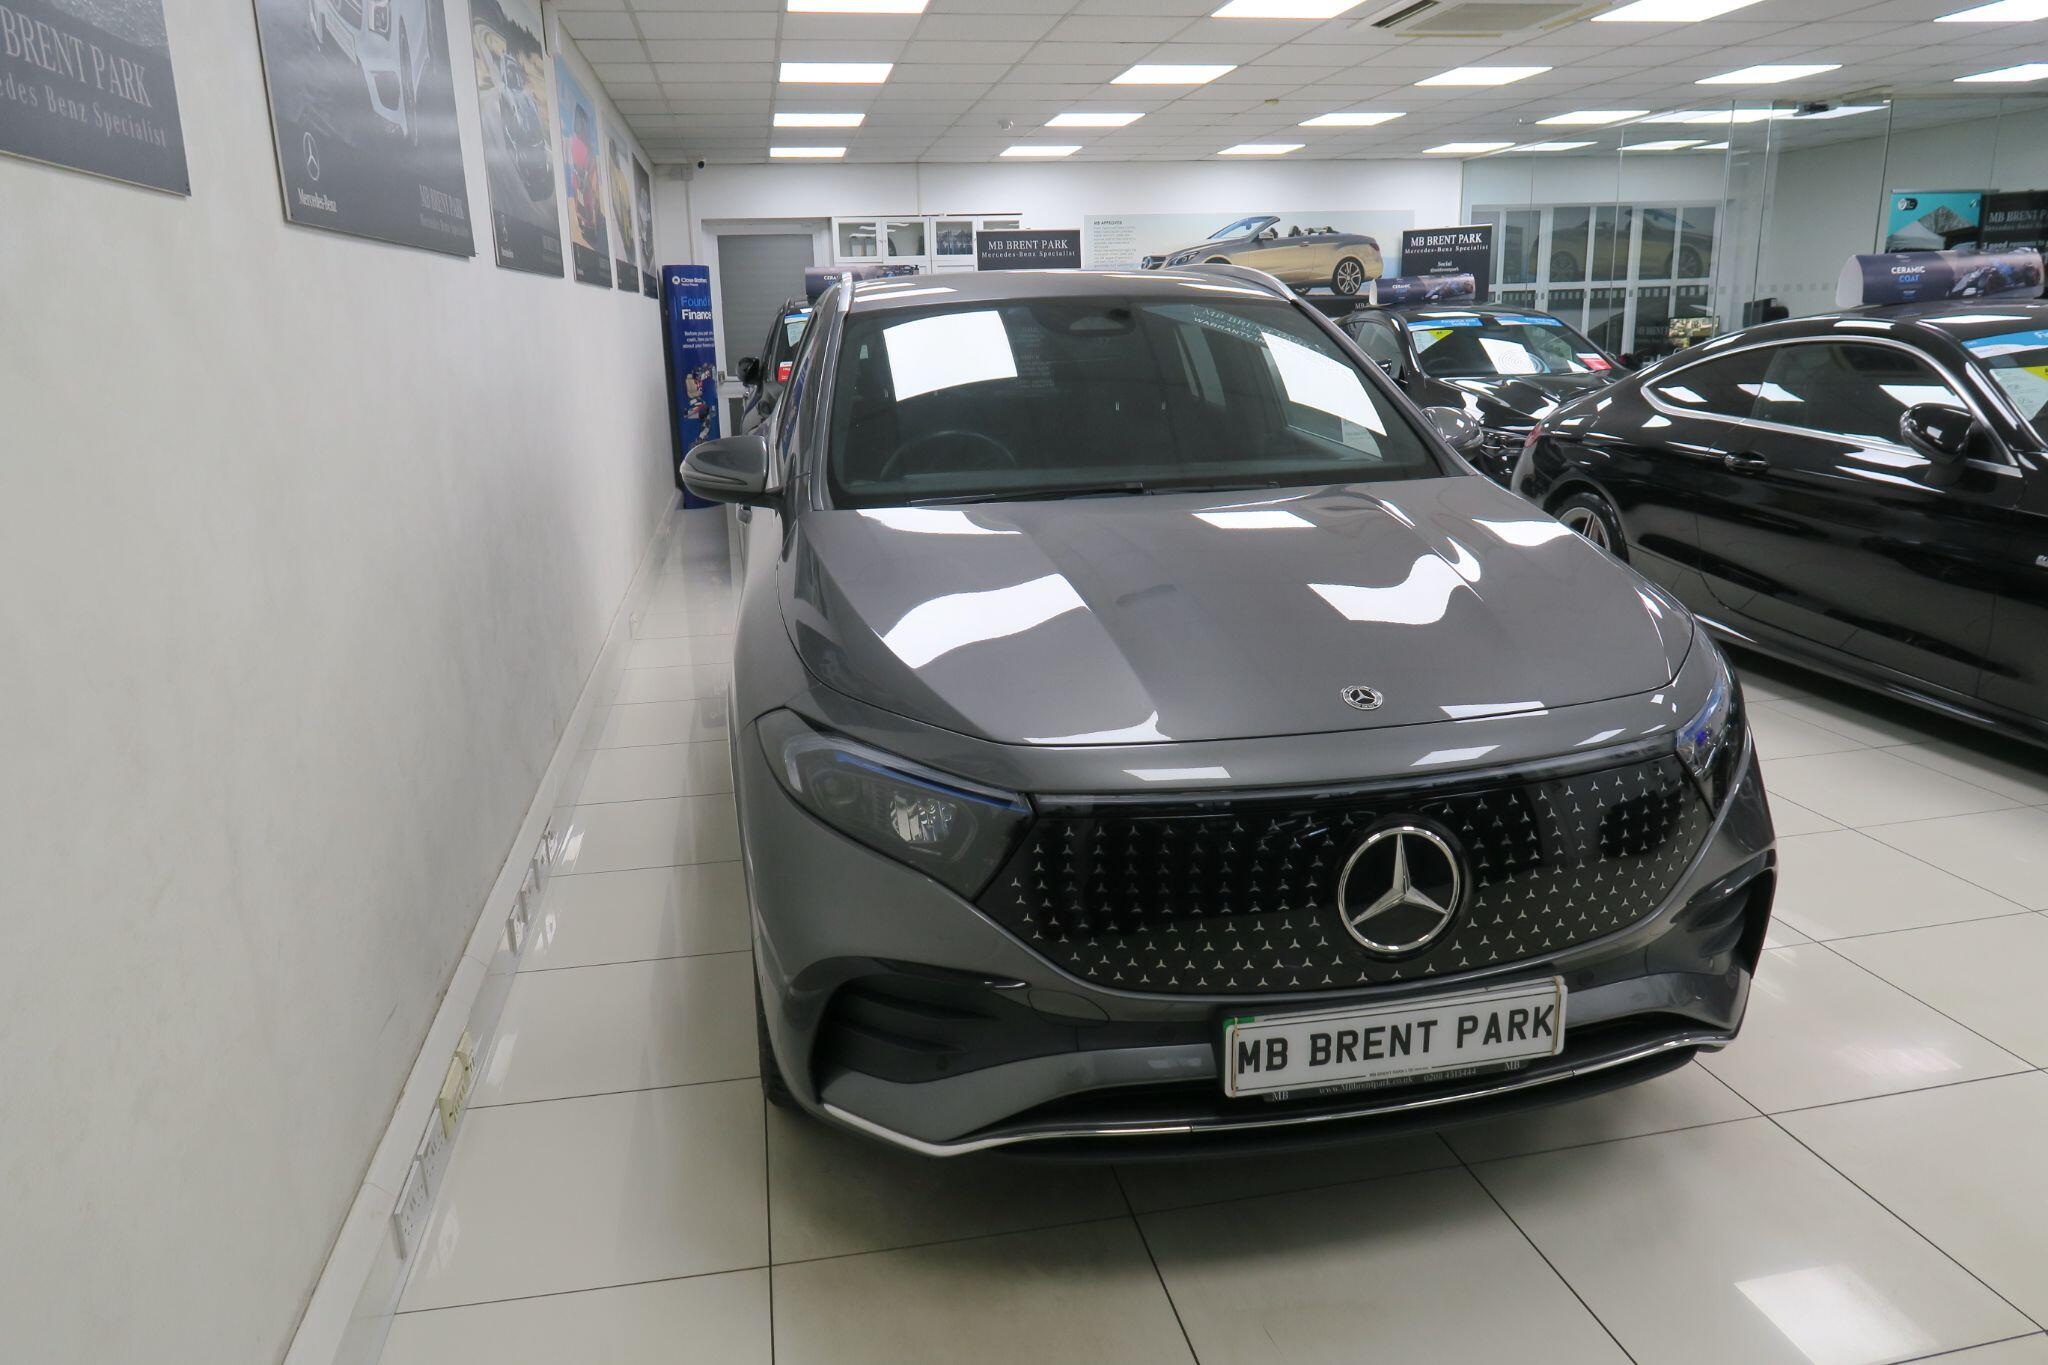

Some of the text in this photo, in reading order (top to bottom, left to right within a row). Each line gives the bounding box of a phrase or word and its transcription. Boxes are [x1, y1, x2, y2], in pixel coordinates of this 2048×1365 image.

[0, 5, 153, 108] BRENT PARK
[45, 85, 87, 123] Benz
[93, 101, 167, 148] Specialist
[988, 239, 1068, 251] MB BRENT PARK
[1410, 233, 1482, 247] MB BRENT PARK
[1039, 250, 1075, 259] Specialist
[1404, 244, 1489, 255] Mercedes-Benz Specialist
[1891, 265, 1926, 275] CERAMIC
[680, 295, 708, 307] Found
[1194, 317, 1252, 338] WARRANTY
[1238, 1004, 1555, 1074] MB BRENT PARK
[1272, 1090, 1288, 1102] MB
[1505, 1060, 1520, 1071] MB
